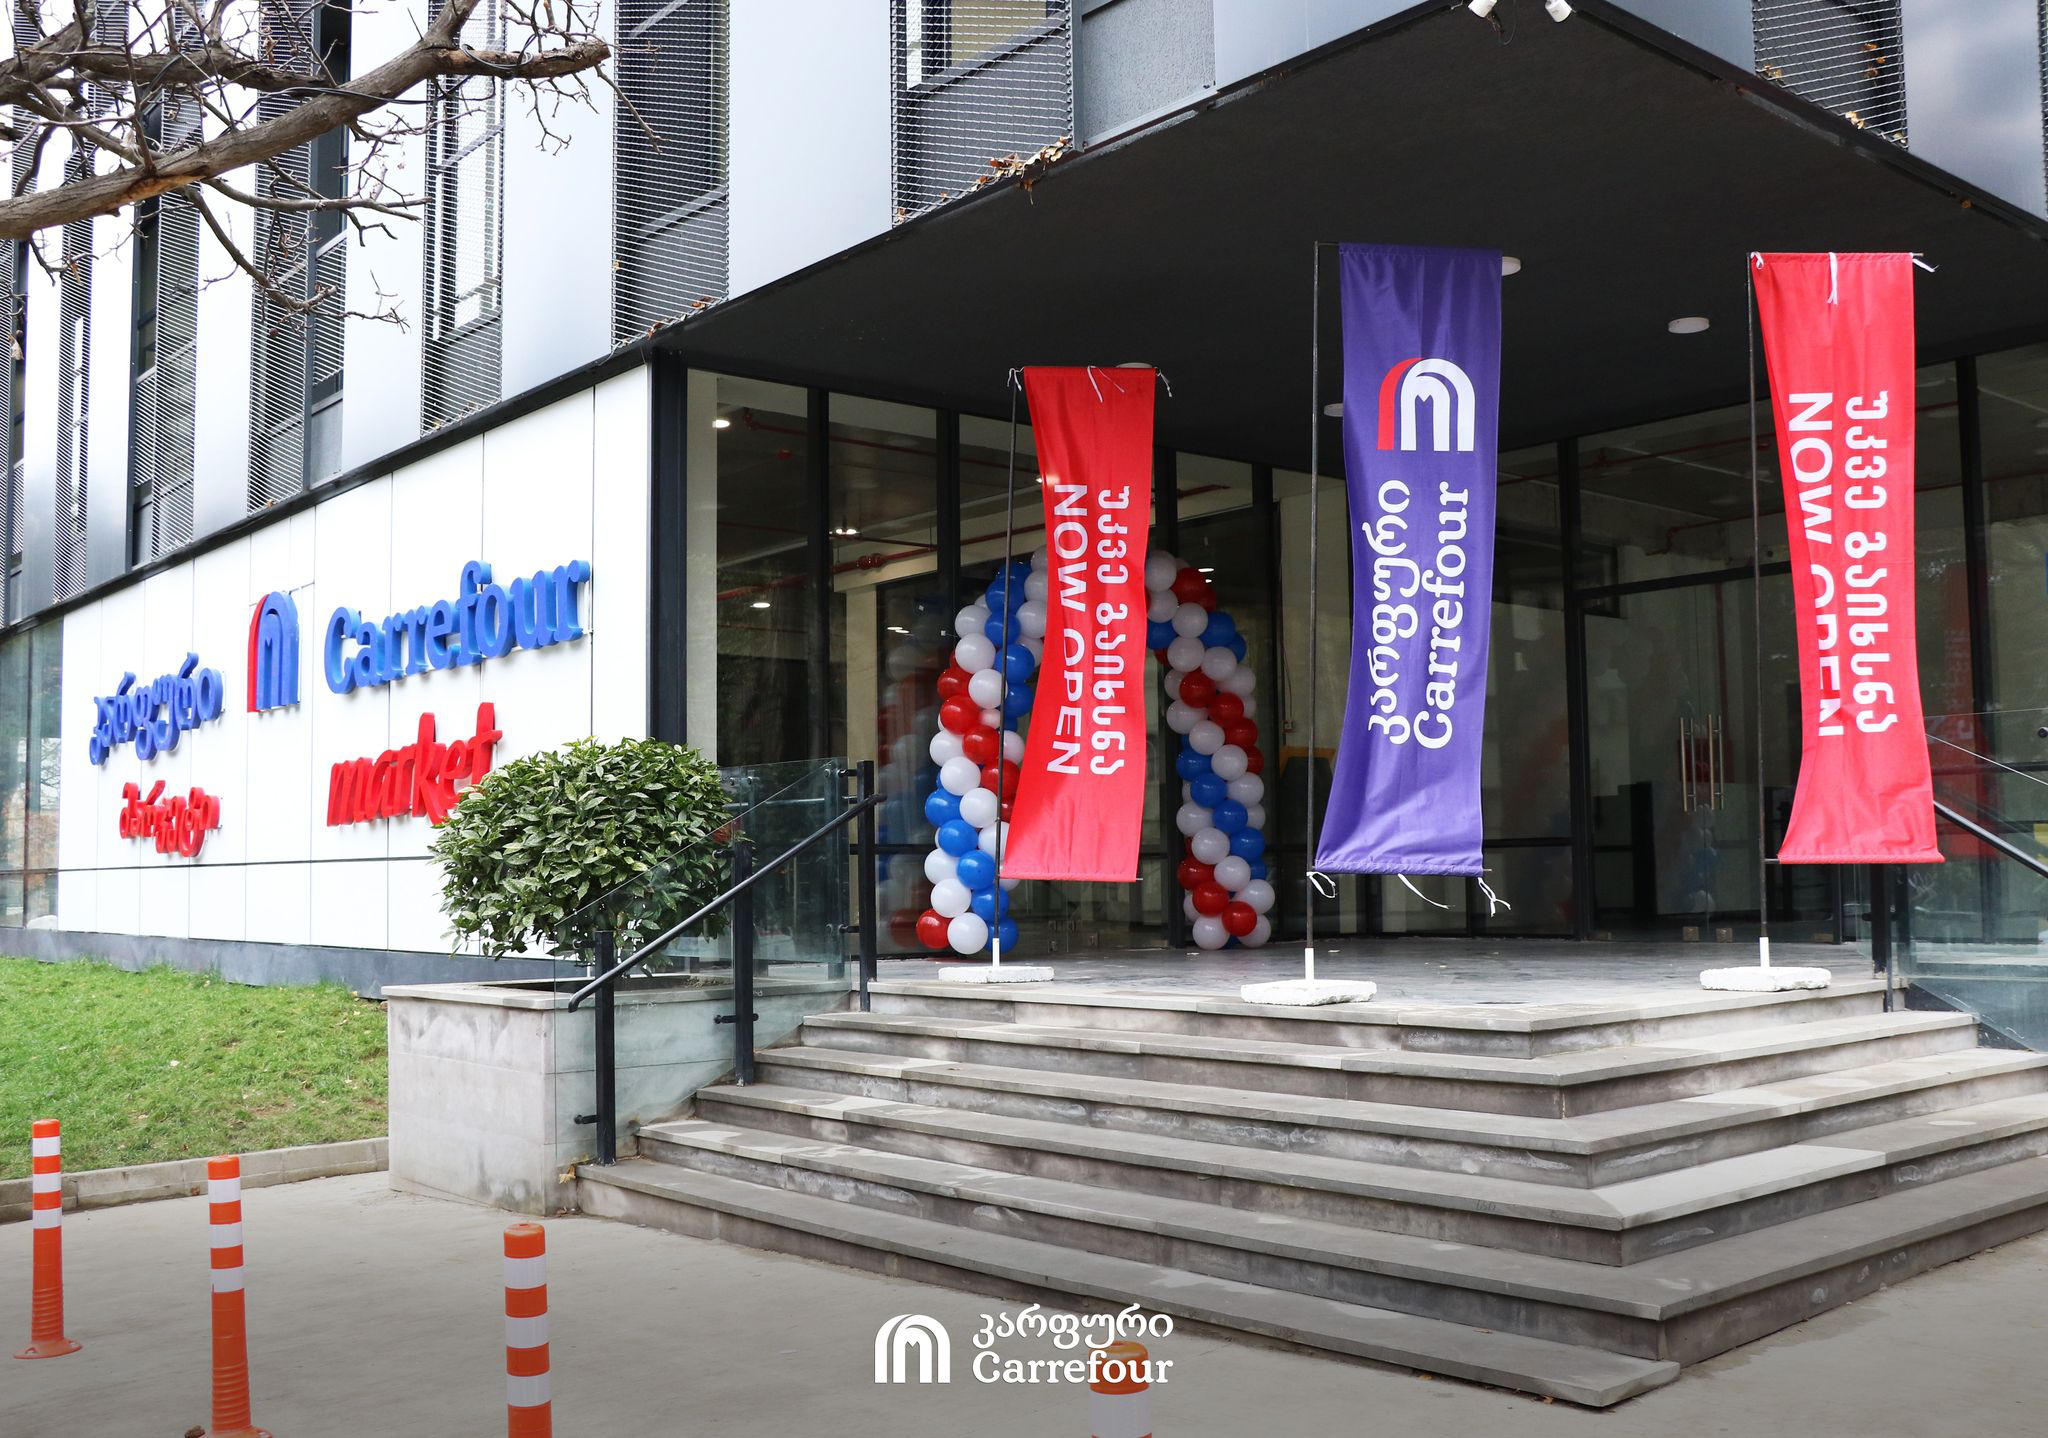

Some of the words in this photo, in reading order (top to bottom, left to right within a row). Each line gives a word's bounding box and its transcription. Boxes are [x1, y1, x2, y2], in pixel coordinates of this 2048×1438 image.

[1788, 392, 1833, 544] NOW
[1845, 390, 1888, 509] უკვე
[1053, 484, 1089, 612] NOW
[1095, 485, 1130, 584] უკვე
[324, 559, 591, 694] Carrefour
[1361, 480, 1420, 745] კარფური
[1413, 481, 1469, 749] Carrefour
[1844, 531, 1898, 733] გაიხსნა
[89, 651, 224, 766] კარფური
[1046, 628, 1085, 775] OPEN
[1090, 602, 1129, 775] გაიხსნა
[327, 702, 503, 827] market
